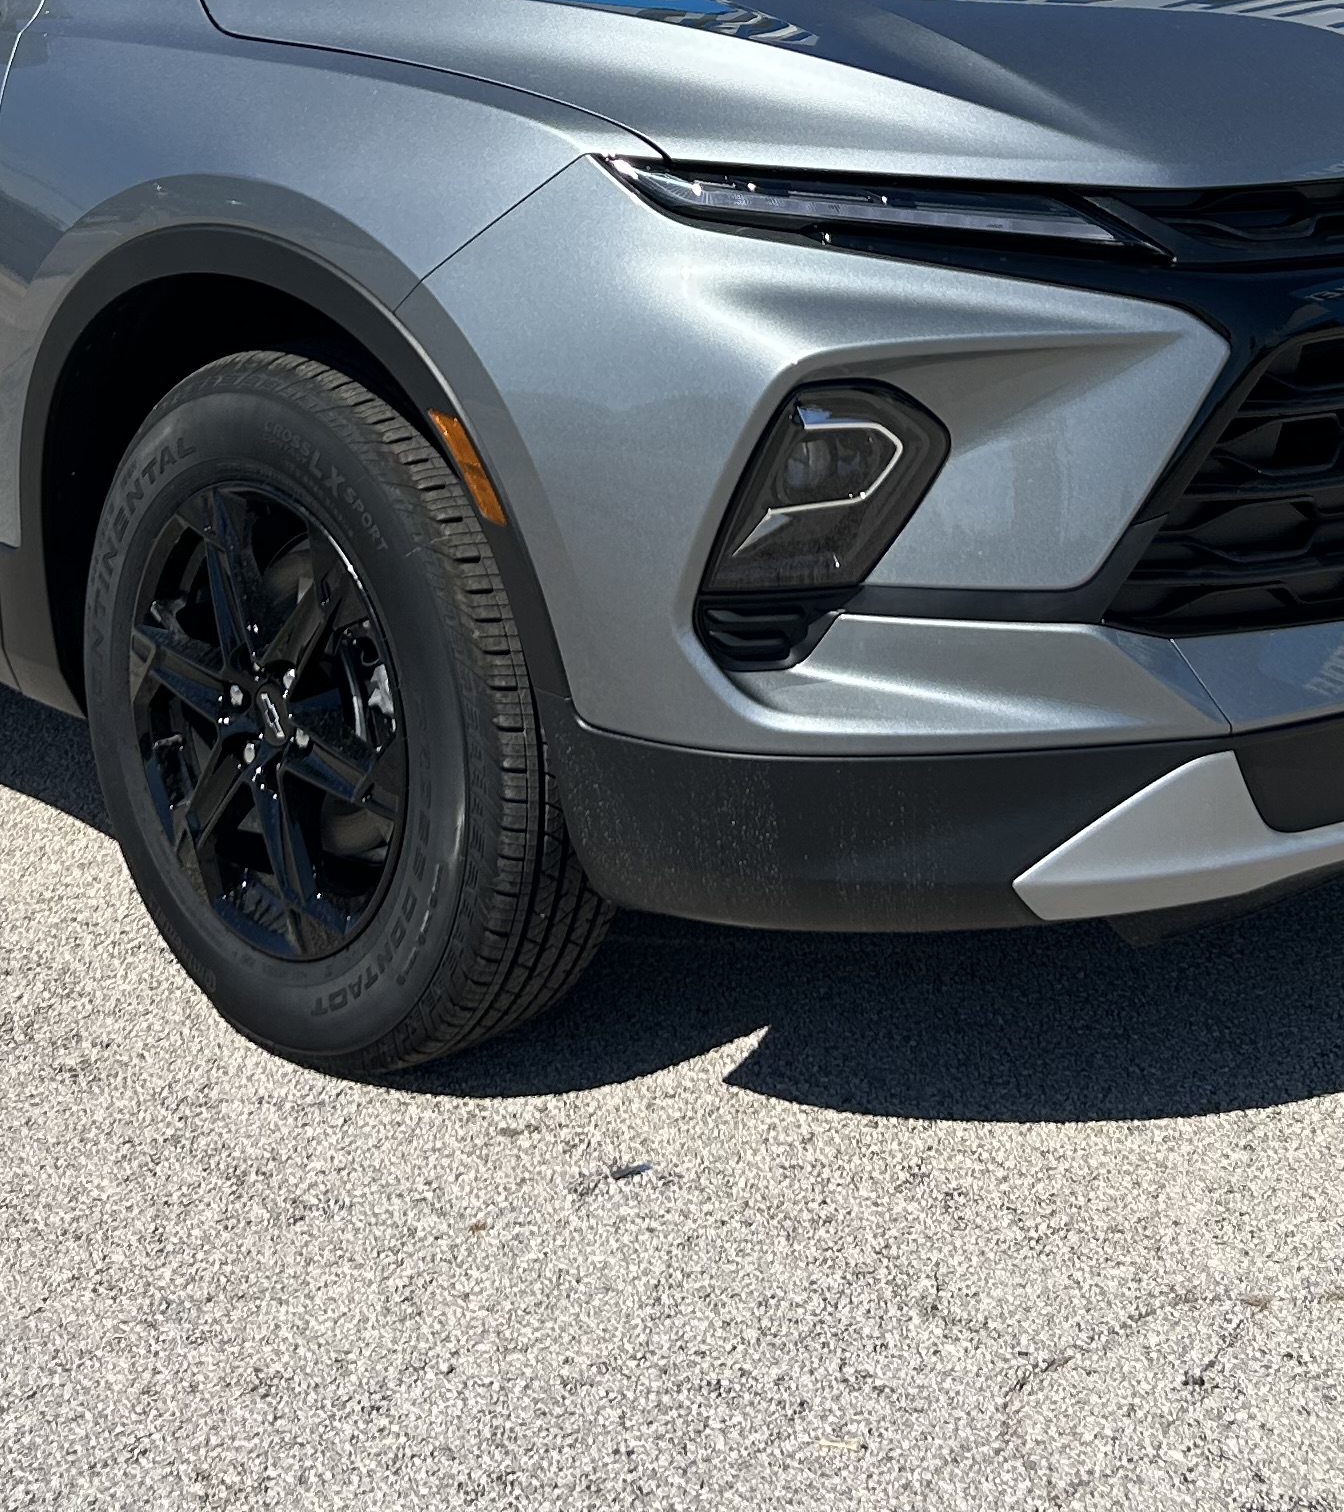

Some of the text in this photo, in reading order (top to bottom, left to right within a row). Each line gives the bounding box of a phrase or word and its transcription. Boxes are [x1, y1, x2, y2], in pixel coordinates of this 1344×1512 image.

[92, 437, 197, 673] NTINENTAL
[343, 487, 388, 550] SPORT
[310, 885, 418, 1018] CONTACT
